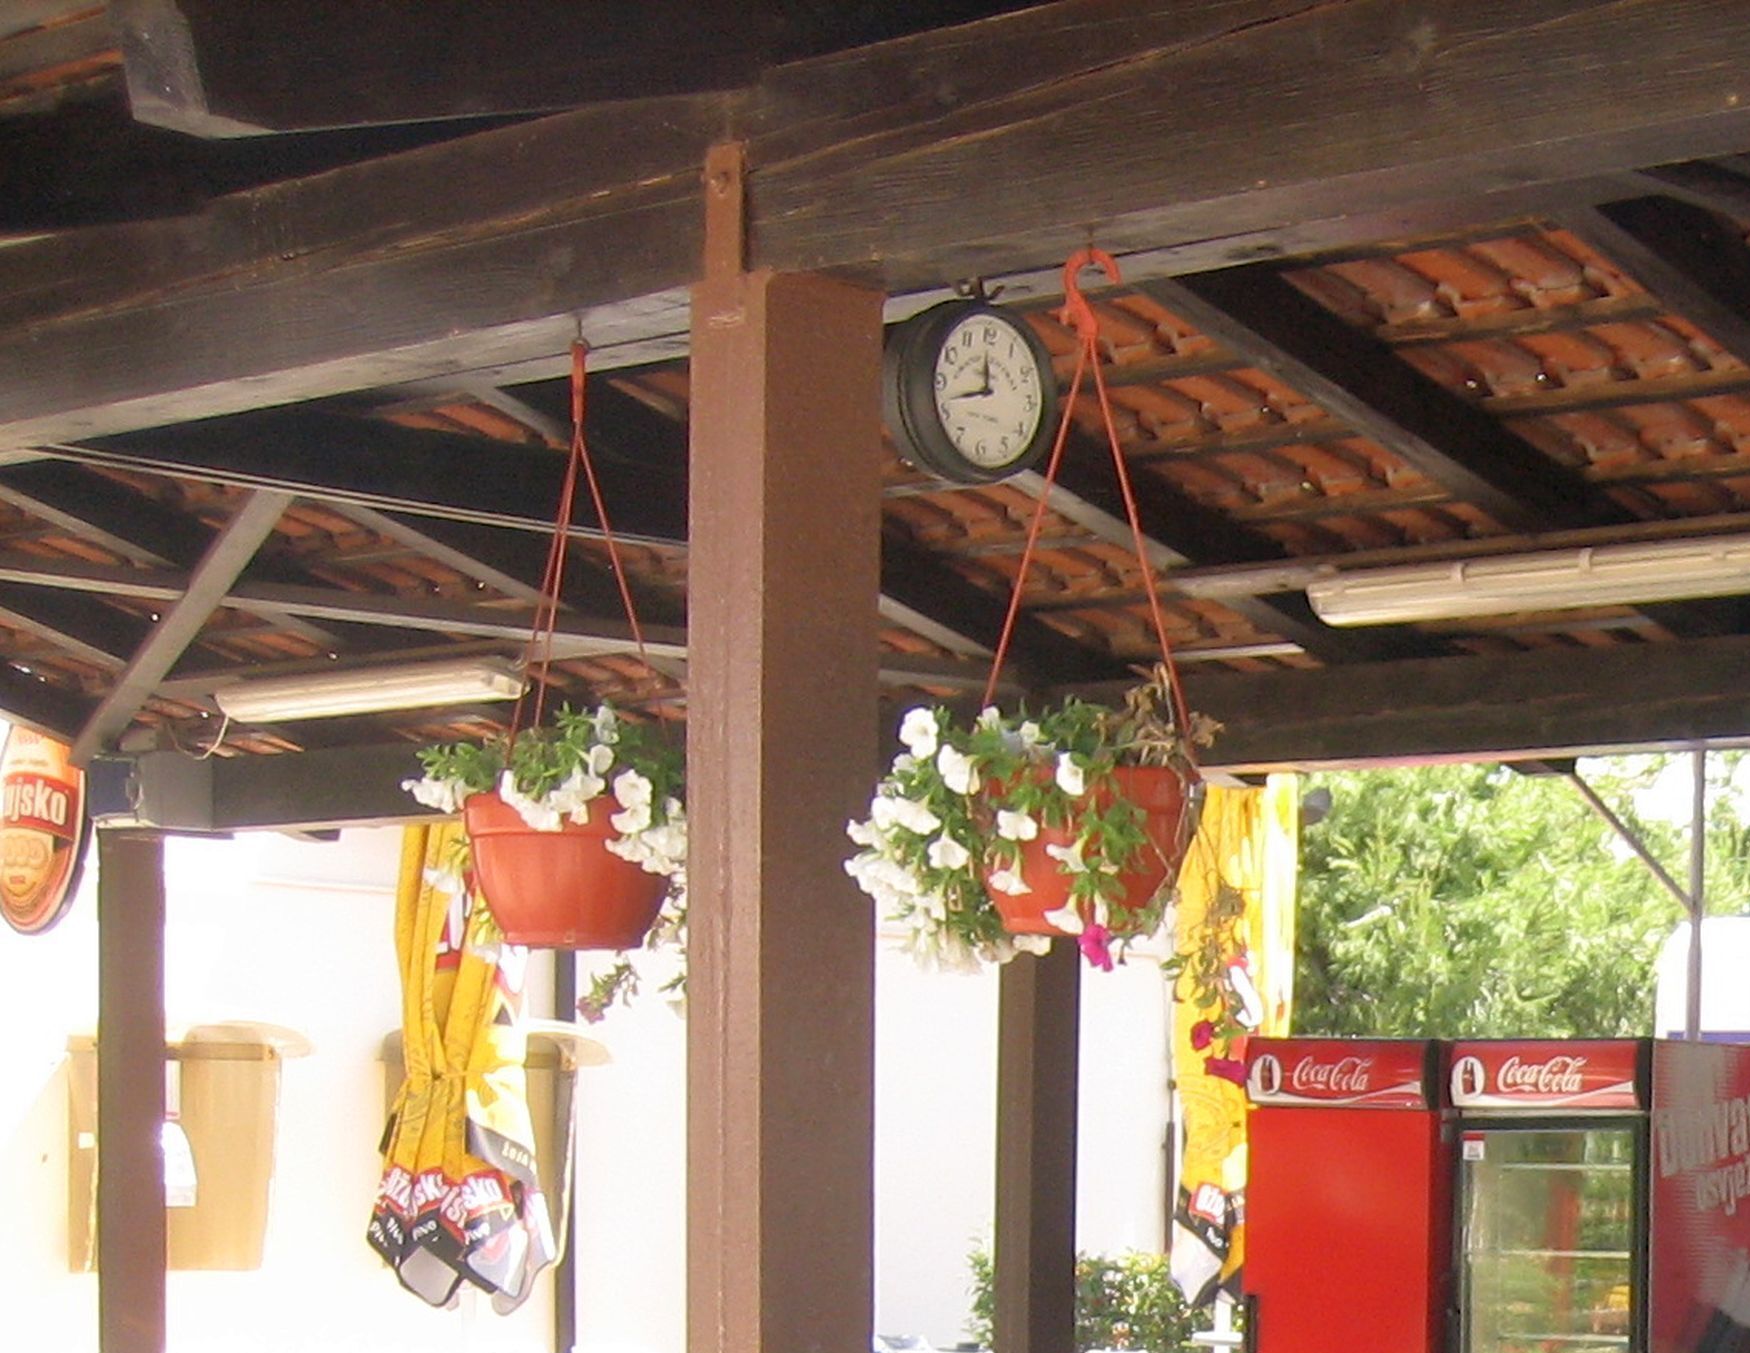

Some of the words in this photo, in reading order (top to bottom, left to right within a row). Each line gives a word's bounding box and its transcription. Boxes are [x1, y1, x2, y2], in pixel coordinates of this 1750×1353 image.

[962, 331, 973, 347] 11
[984, 327, 997, 345] 12
[945, 347, 957, 364] 10
[1009, 343, 1014, 357] 1
[935, 372, 947, 390] 9
[1020, 367, 1034, 383] 2
[1025, 395, 1037, 411] 3
[941, 404, 950, 420] 8
[957, 427, 965, 444] 7
[1013, 422, 1023, 436] 4
[975, 441, 986, 455] 6
[1001, 437, 1008, 458] 5
